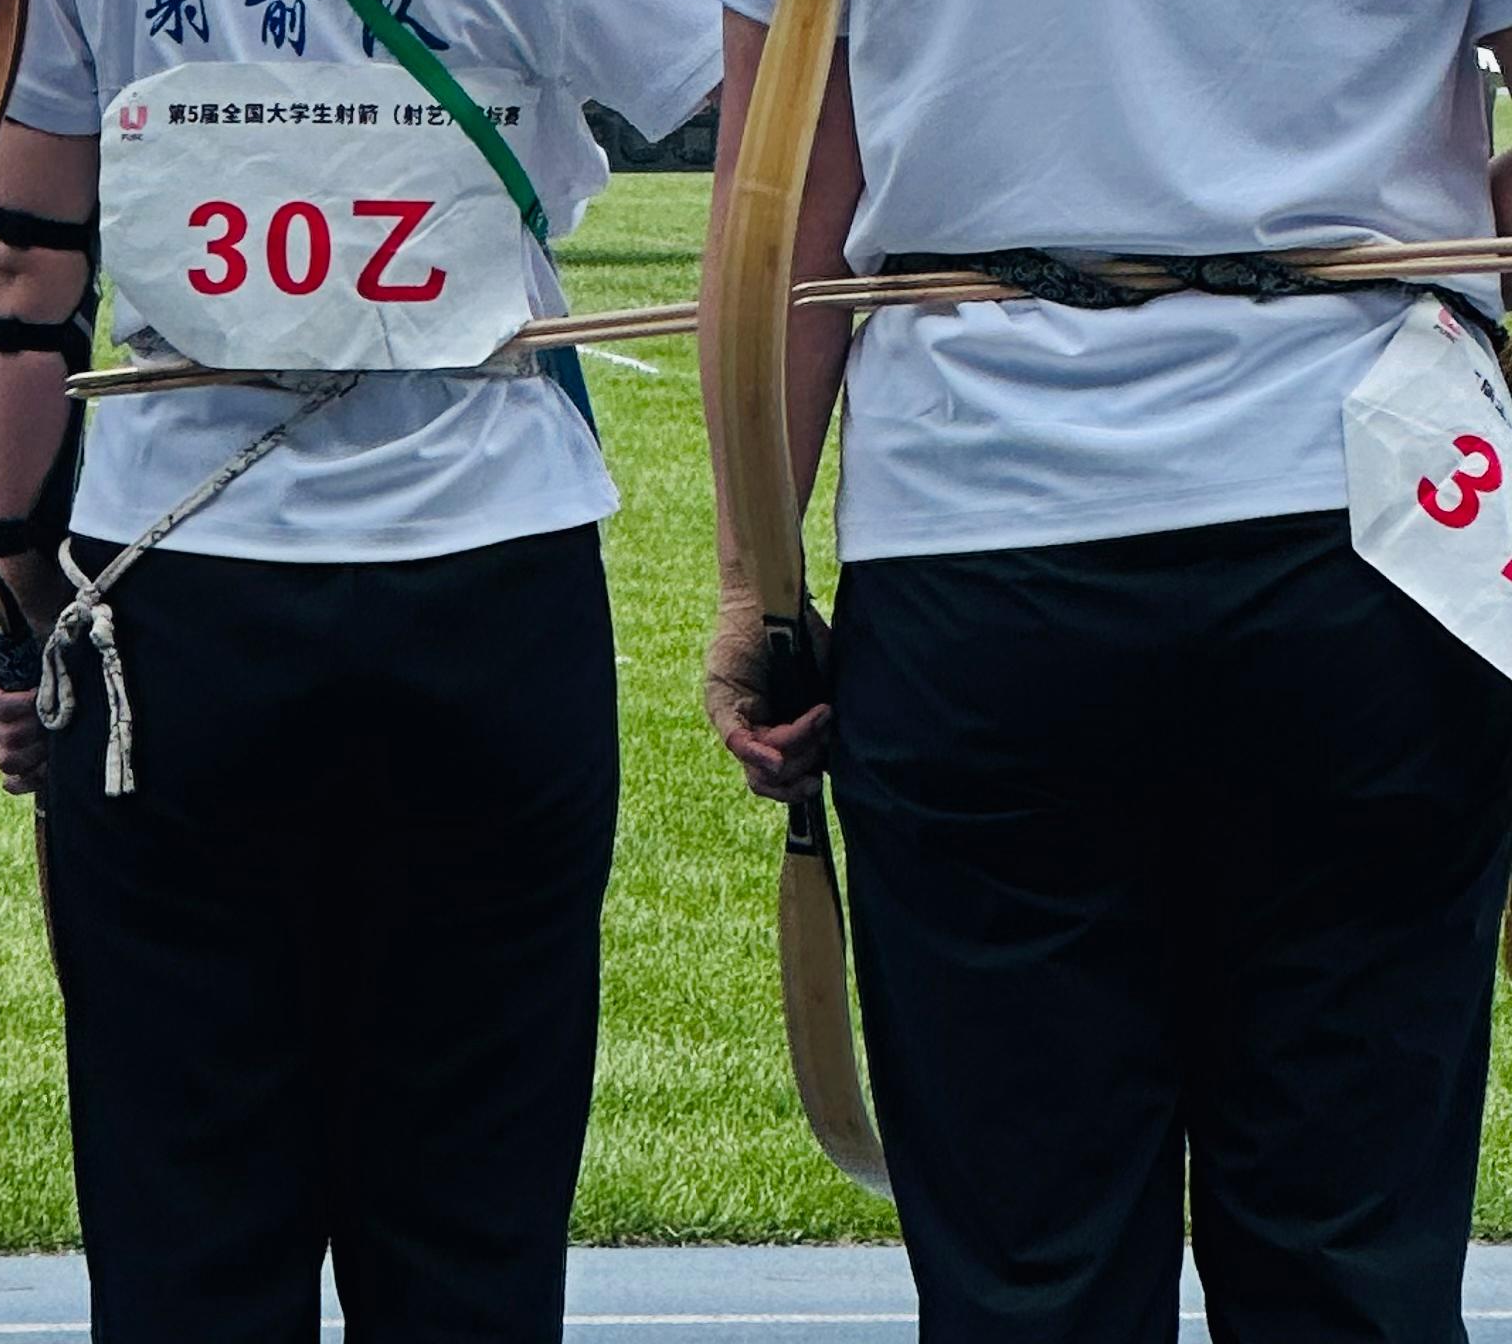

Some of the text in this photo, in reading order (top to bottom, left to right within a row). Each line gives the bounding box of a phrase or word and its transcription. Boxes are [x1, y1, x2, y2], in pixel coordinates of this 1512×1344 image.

[168, 102, 521, 128] 第5届全国大学生射箭（射艺）标赛
[187, 198, 447, 304] 30乙
[1417, 434, 1512, 578] 3
